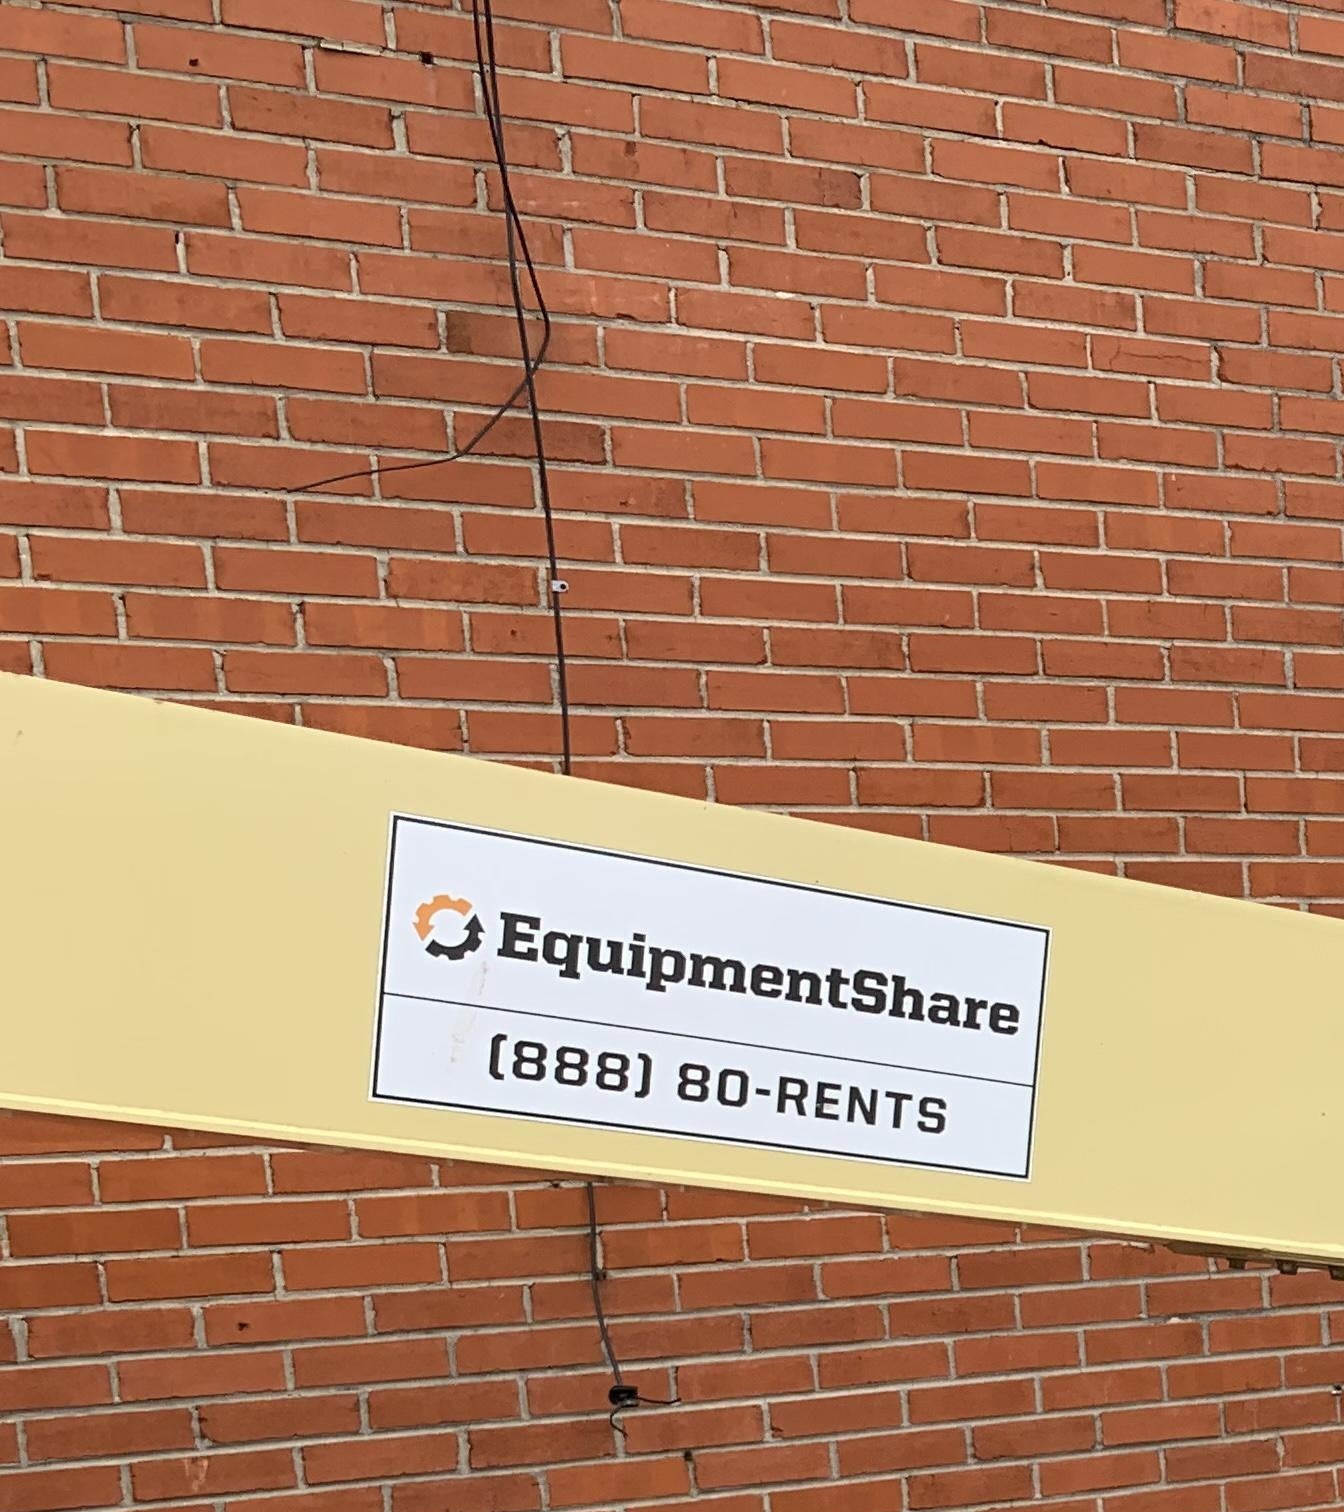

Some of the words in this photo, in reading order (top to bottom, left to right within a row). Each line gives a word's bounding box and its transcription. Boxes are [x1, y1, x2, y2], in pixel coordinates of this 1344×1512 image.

[497, 911, 1020, 1036] EquipmentShare
[488, 1034, 652, 1098] (888)
[677, 1062, 948, 1134] 80-RENTS
